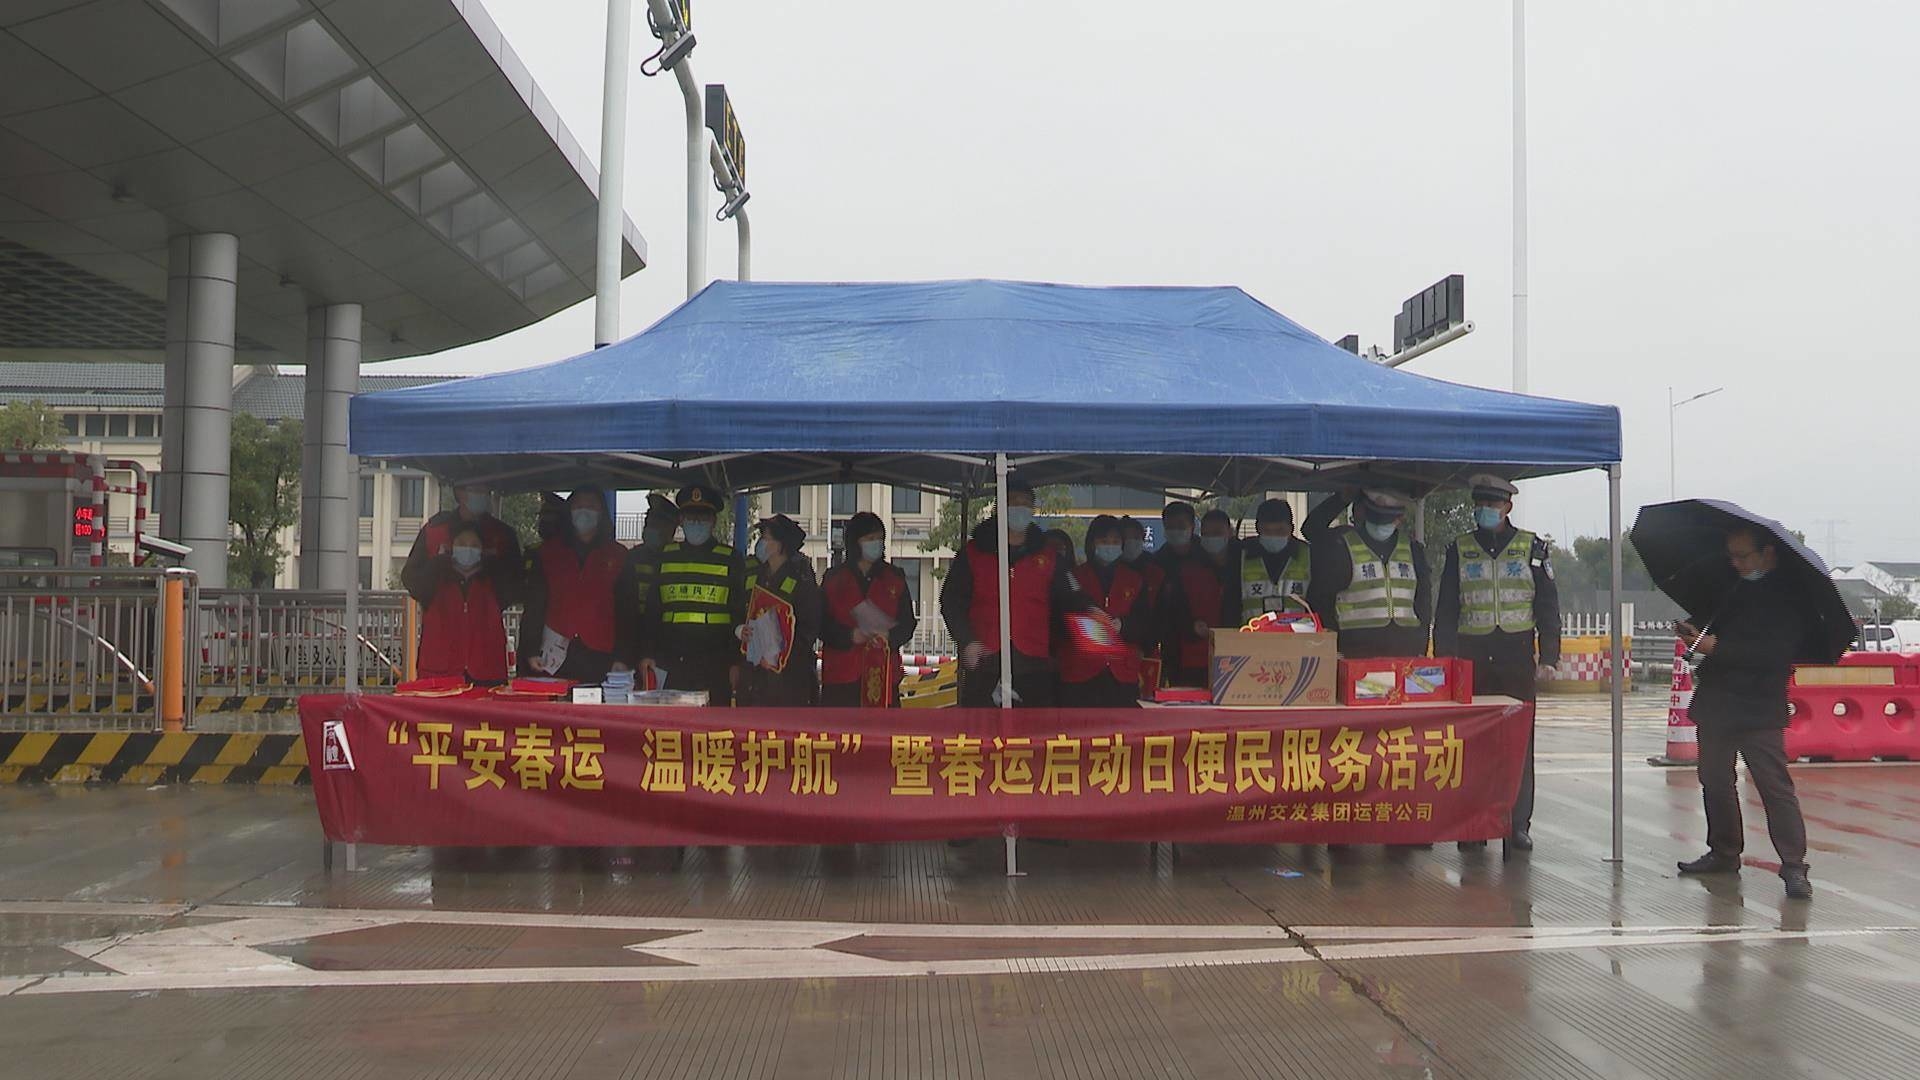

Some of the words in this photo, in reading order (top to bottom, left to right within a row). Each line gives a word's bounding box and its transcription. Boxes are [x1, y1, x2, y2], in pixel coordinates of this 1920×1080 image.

[387, 721, 606, 791] “平安春运
[1226, 803, 1434, 822] 温州交发集团运营公司
